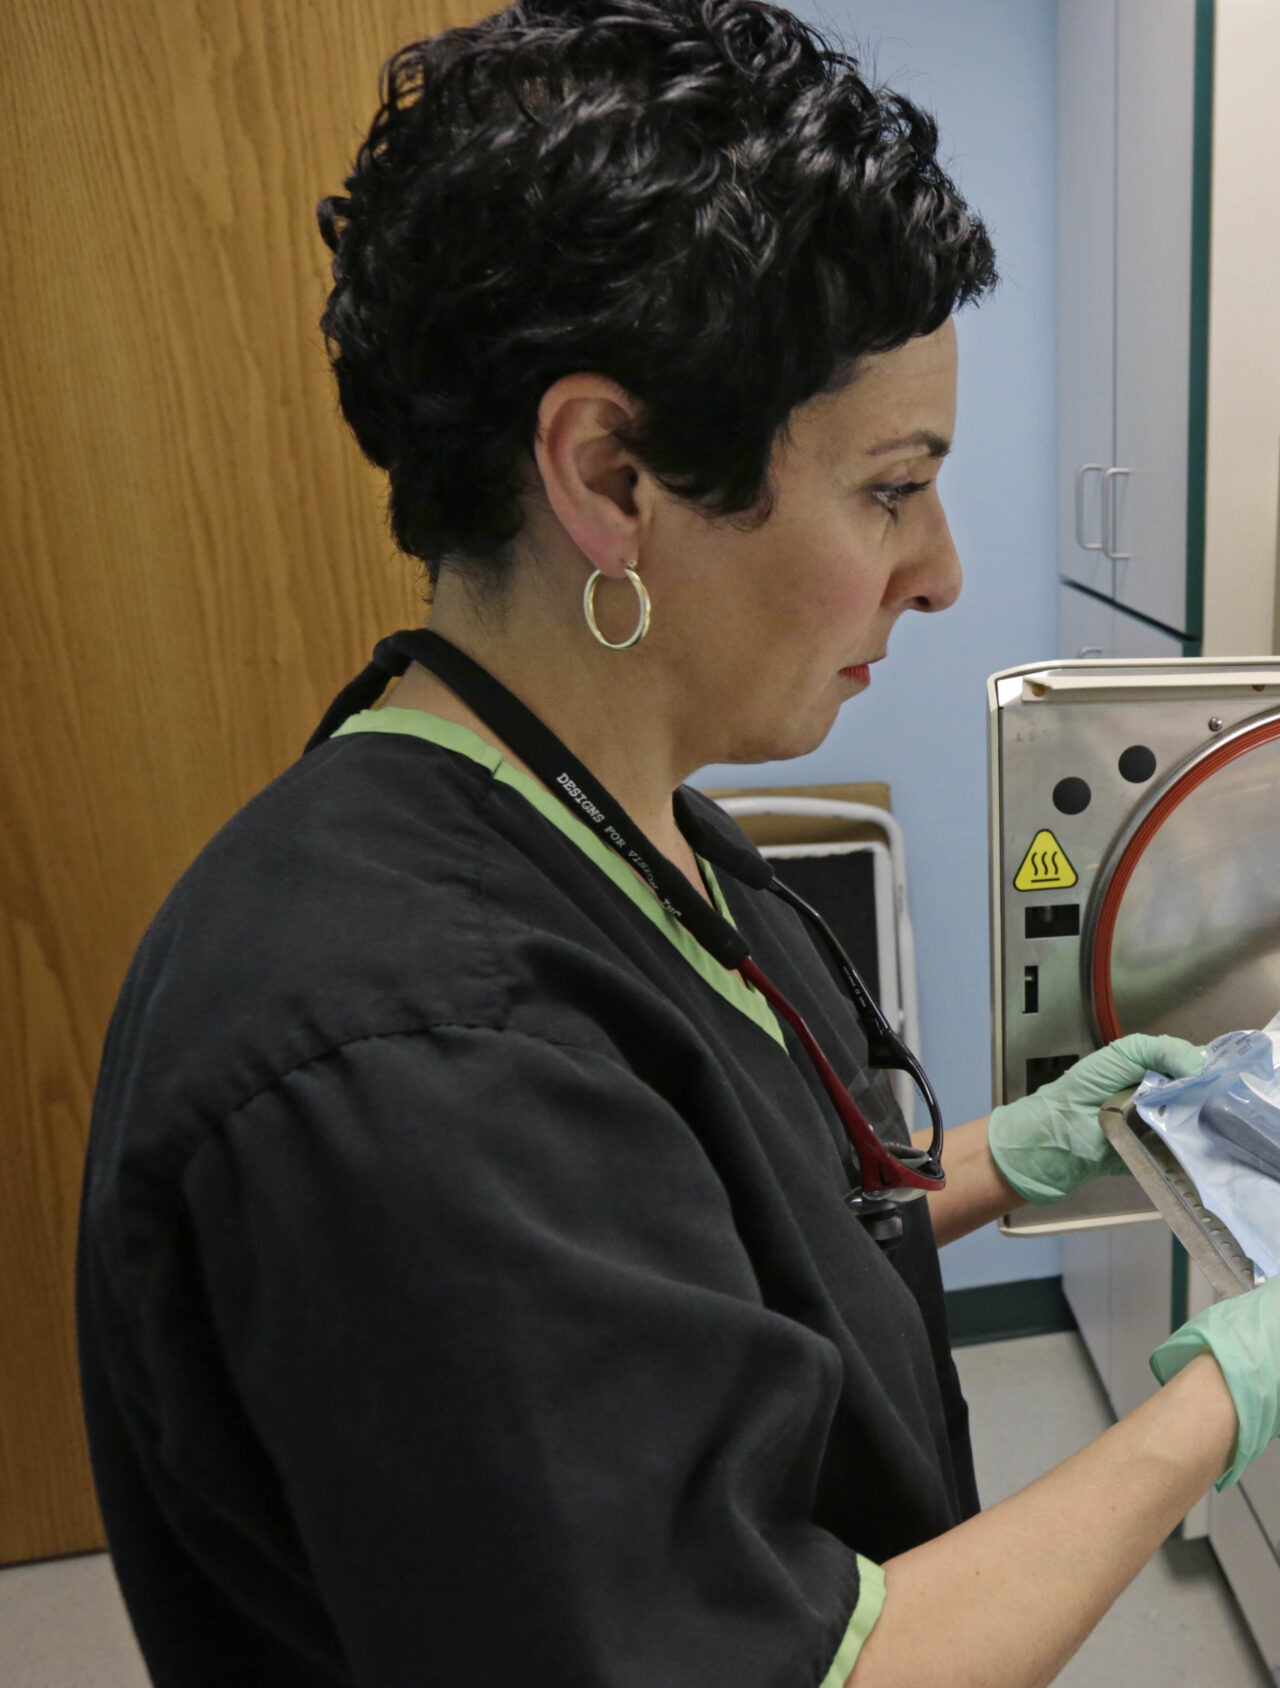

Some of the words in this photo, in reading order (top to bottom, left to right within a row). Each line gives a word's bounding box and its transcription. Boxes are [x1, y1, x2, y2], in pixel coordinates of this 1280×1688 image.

[556, 772, 605, 823] DESIGNS
[604, 825, 627, 848] FOR
[628, 850, 659, 889] VISION
